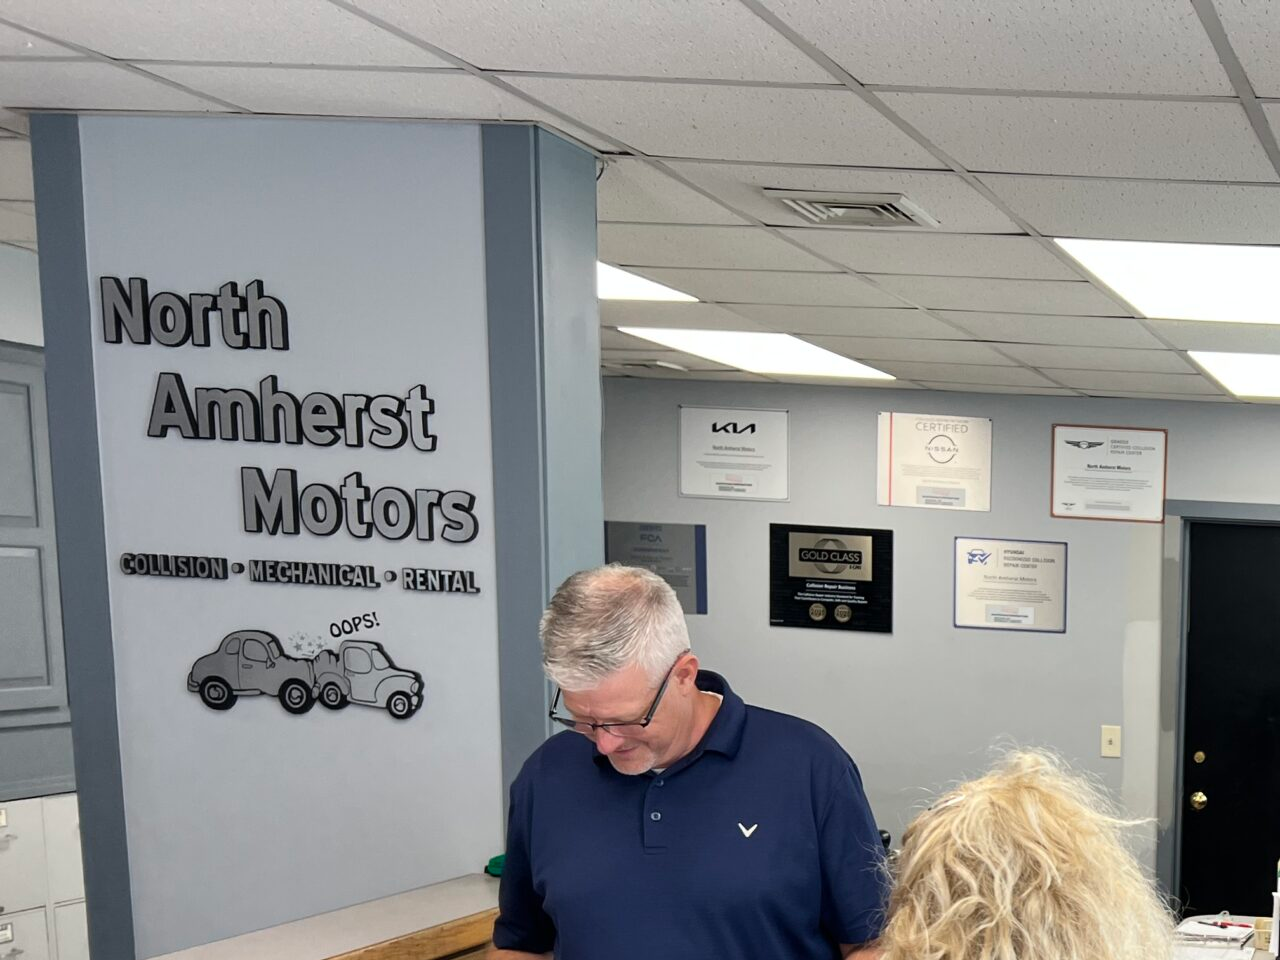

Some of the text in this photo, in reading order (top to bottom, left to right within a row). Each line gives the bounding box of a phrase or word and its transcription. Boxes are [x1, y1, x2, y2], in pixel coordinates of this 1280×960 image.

[100, 276, 289, 351] North
[147, 372, 437, 452] Amherst
[712, 422, 756, 434] KIA
[915, 422, 968, 434] CERTIFIED
[924, 445, 959, 453] NISSAN
[240, 466, 479, 544] Motors
[801, 550, 860, 563] GOLD CLASS
[120, 553, 481, 593] COLLISION MECHANICAL RENTAL
[329, 612, 380, 638] OOPS!
